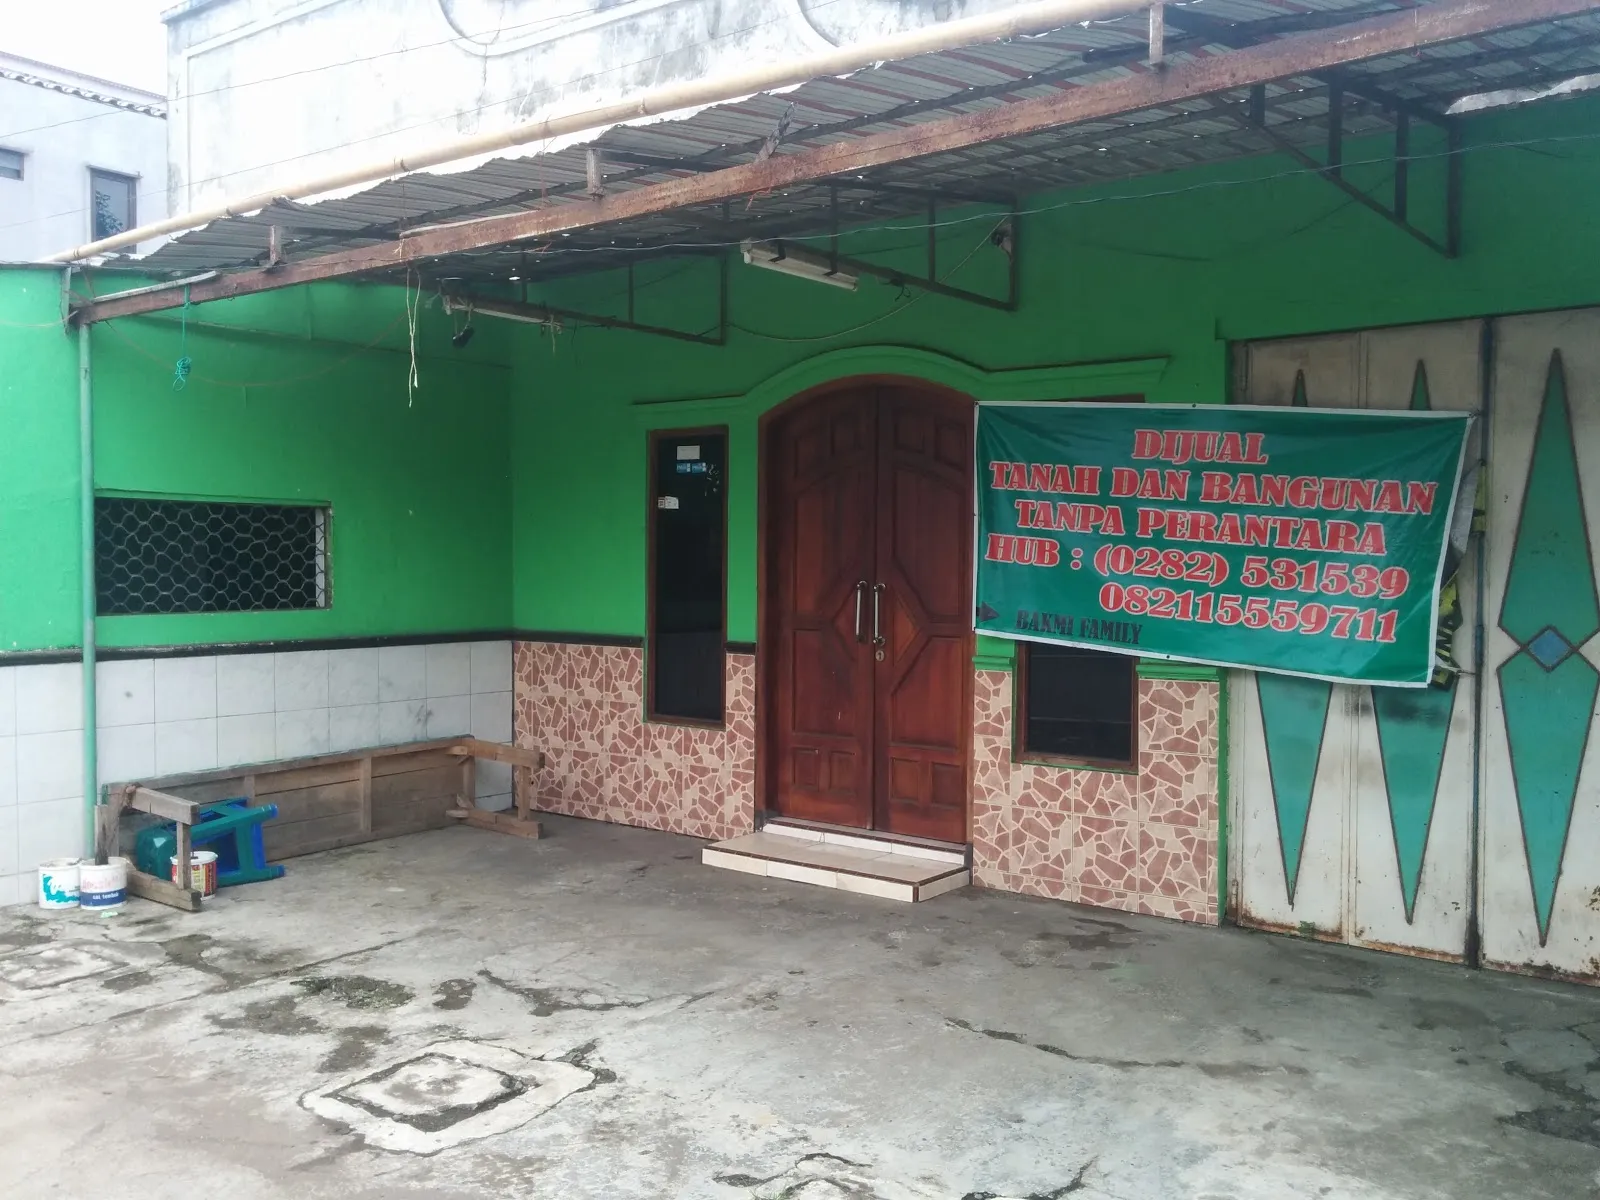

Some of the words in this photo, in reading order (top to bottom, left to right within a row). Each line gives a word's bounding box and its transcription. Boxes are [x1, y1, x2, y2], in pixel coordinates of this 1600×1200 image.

[1132, 429, 1268, 465] DIJUAL
[989, 461, 1101, 496] TANAH
[1111, 467, 1191, 501] DAN
[1200, 472, 1438, 515] BANGUNAN
[1014, 499, 1125, 536] TANPA
[1136, 508, 1387, 556] PERANTARA
[985, 533, 1060, 567] HUB
[1094, 543, 1230, 587] (0282)
[1240, 556, 1410, 600] 531539
[1079, 617, 1143, 645] FAMILY
[1099, 582, 1398, 643] 082115559711
